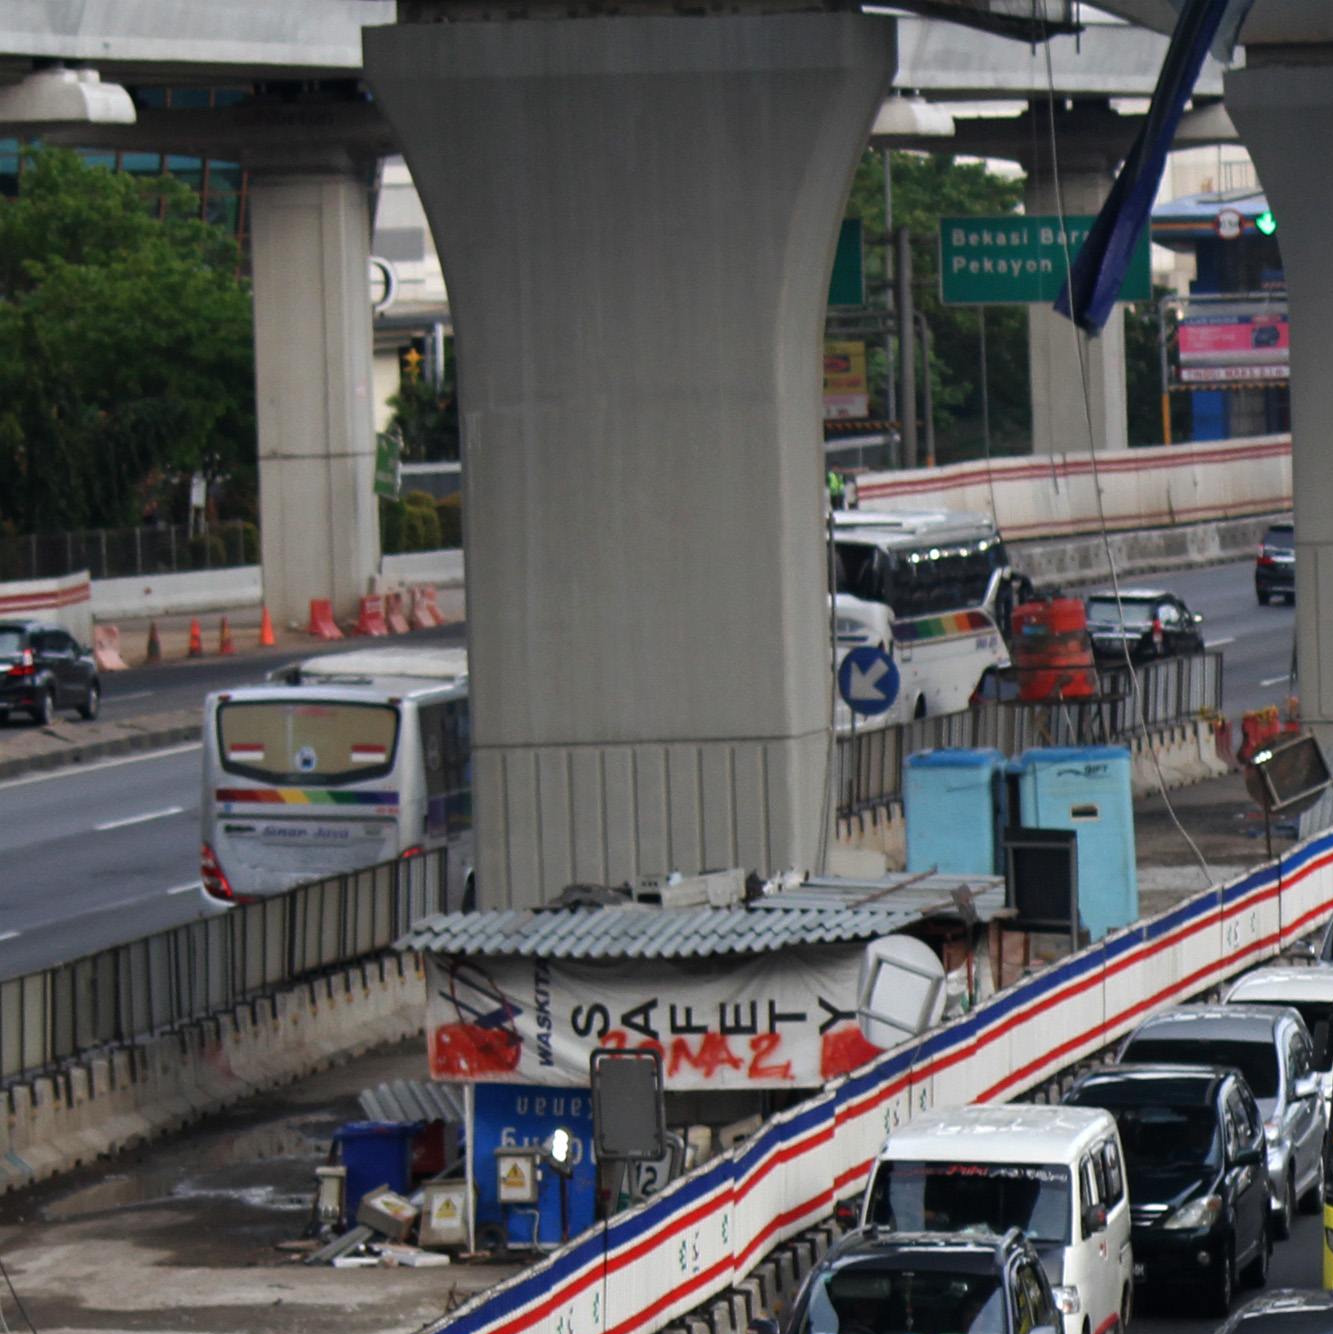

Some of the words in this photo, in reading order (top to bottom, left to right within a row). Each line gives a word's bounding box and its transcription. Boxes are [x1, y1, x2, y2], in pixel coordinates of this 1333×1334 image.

[951, 227, 1029, 246] Bekasi
[951, 255, 1053, 278] Pekayon
[263, 824, 307, 837] Sinar
[571, 997, 860, 1041] SAFETY
